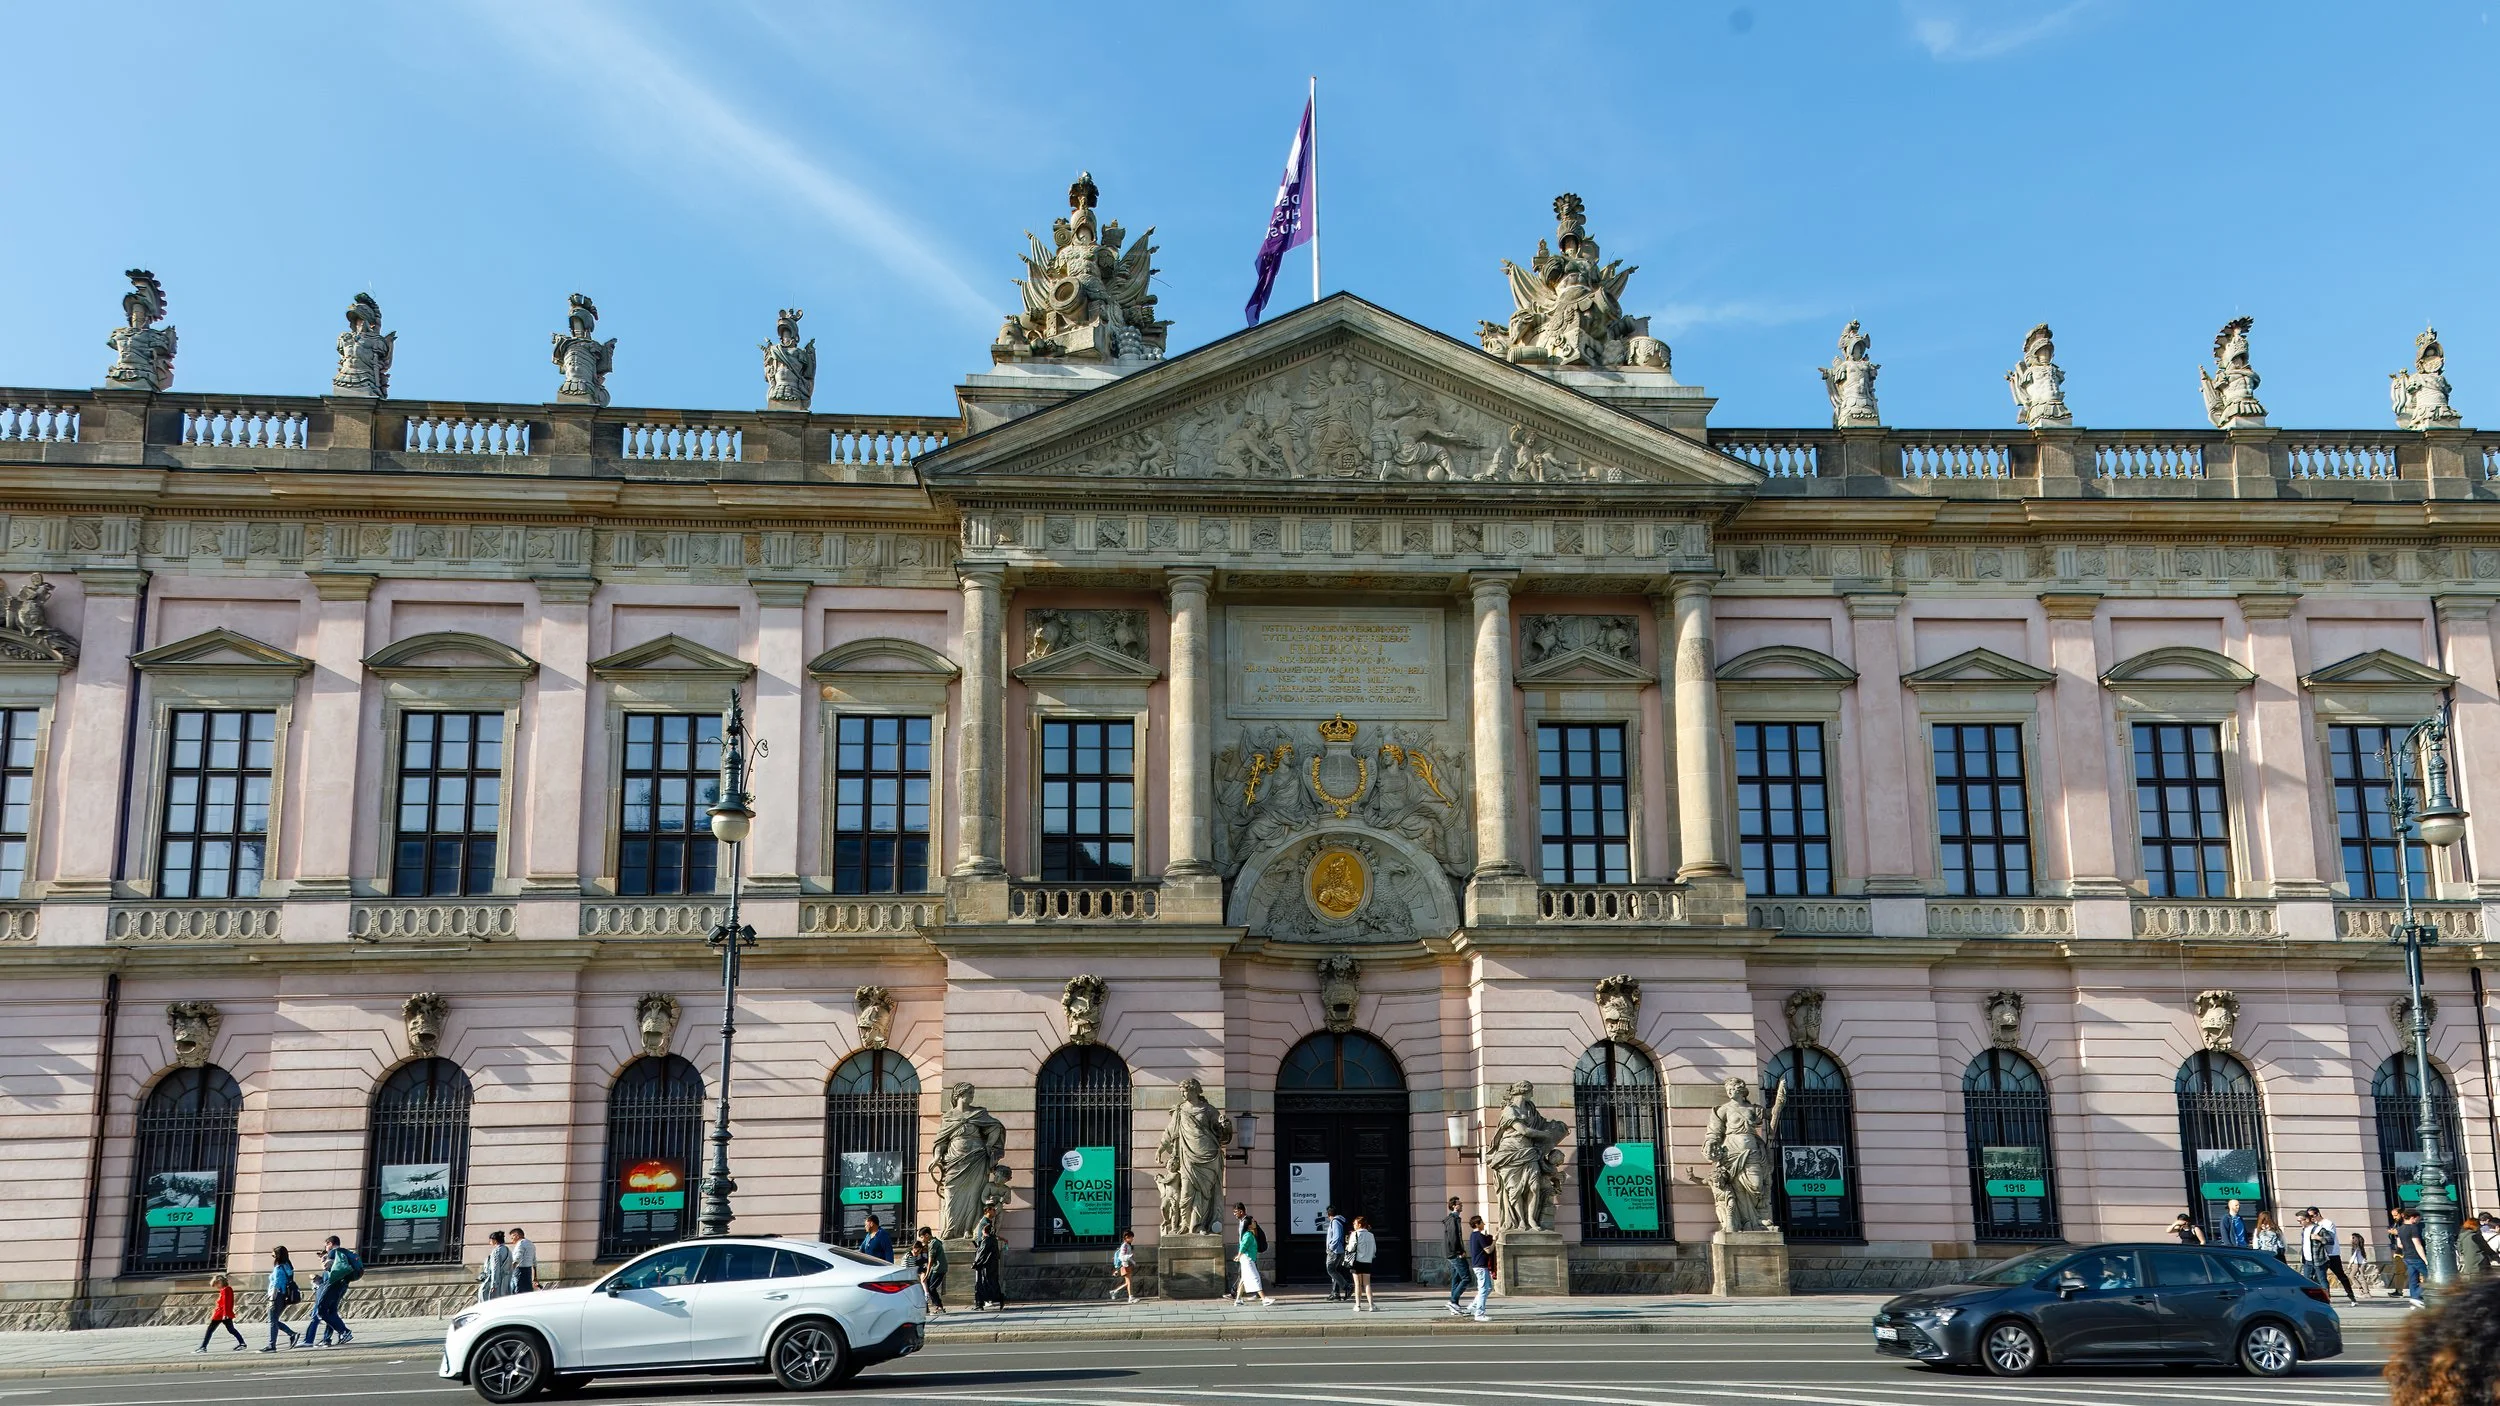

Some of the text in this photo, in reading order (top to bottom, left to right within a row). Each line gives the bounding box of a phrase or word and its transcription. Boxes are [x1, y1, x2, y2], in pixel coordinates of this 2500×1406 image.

[1290, 643, 1369, 655] FRIDERICVS
[1065, 1179, 1112, 1190] ROADS
[1606, 1175, 1653, 1186] ROADS
[1613, 1187, 1654, 1197] TAKEN
[1802, 1183, 1826, 1192] 1929
[2004, 1184, 2026, 1192] 1918
[2219, 1186, 2241, 1195] 1914
[858, 1190, 883, 1199] 1933
[1070, 1191, 1112, 1201] TAKEN
[639, 1196, 665, 1206] 1945
[392, 1204, 437, 1214] 1948/49
[168, 1212, 194, 1221] 1972
